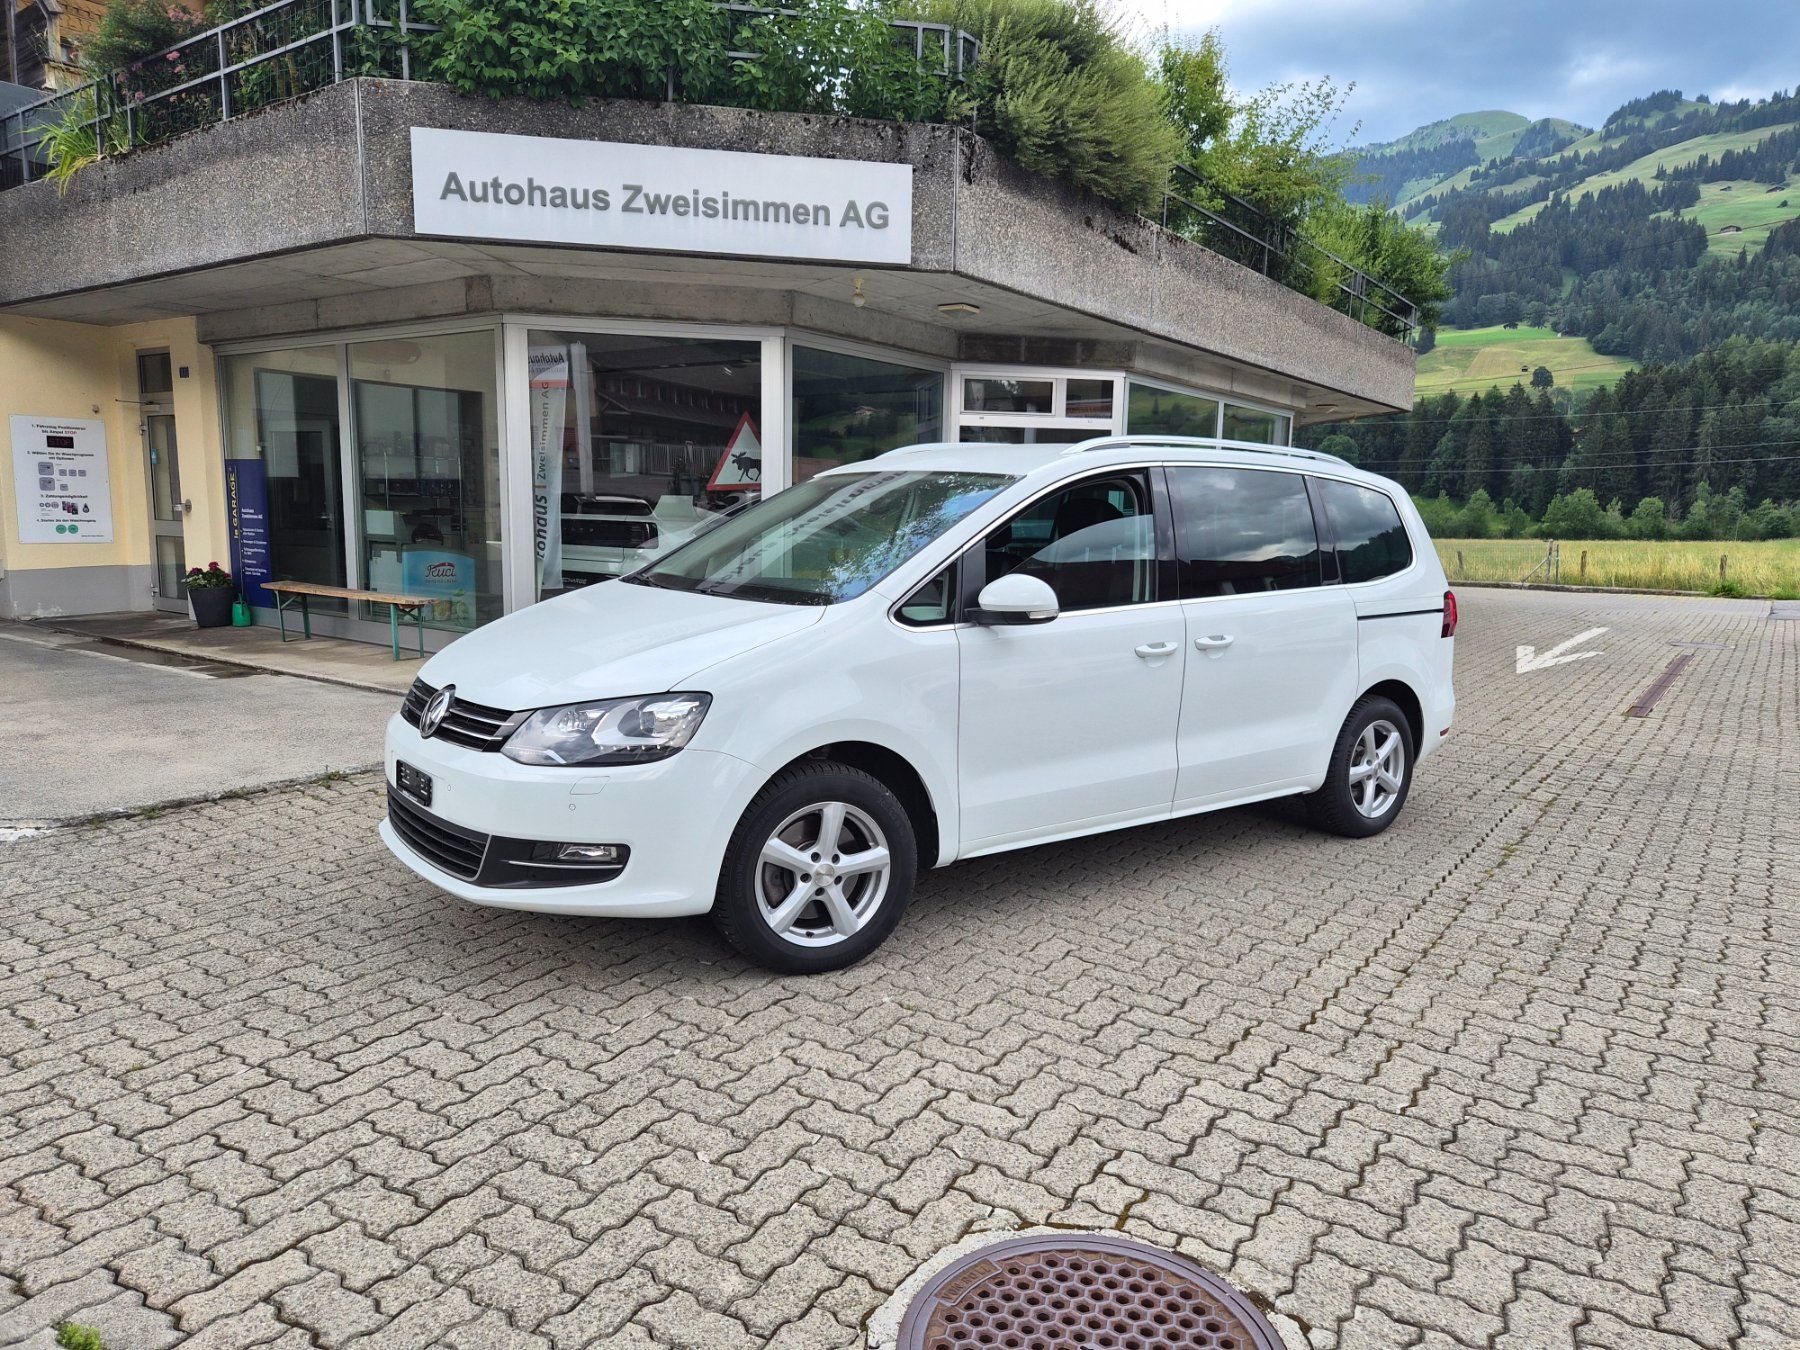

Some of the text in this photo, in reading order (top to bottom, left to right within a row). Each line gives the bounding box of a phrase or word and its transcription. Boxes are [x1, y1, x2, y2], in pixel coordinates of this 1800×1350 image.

[440, 171, 890, 230] Autohaus Zweisimmen AG
[541, 382, 549, 398] AG
[48, 437, 71, 446] STOP
[537, 402, 549, 480] Zweisimmen
[229, 472, 238, 527] GARAGE
